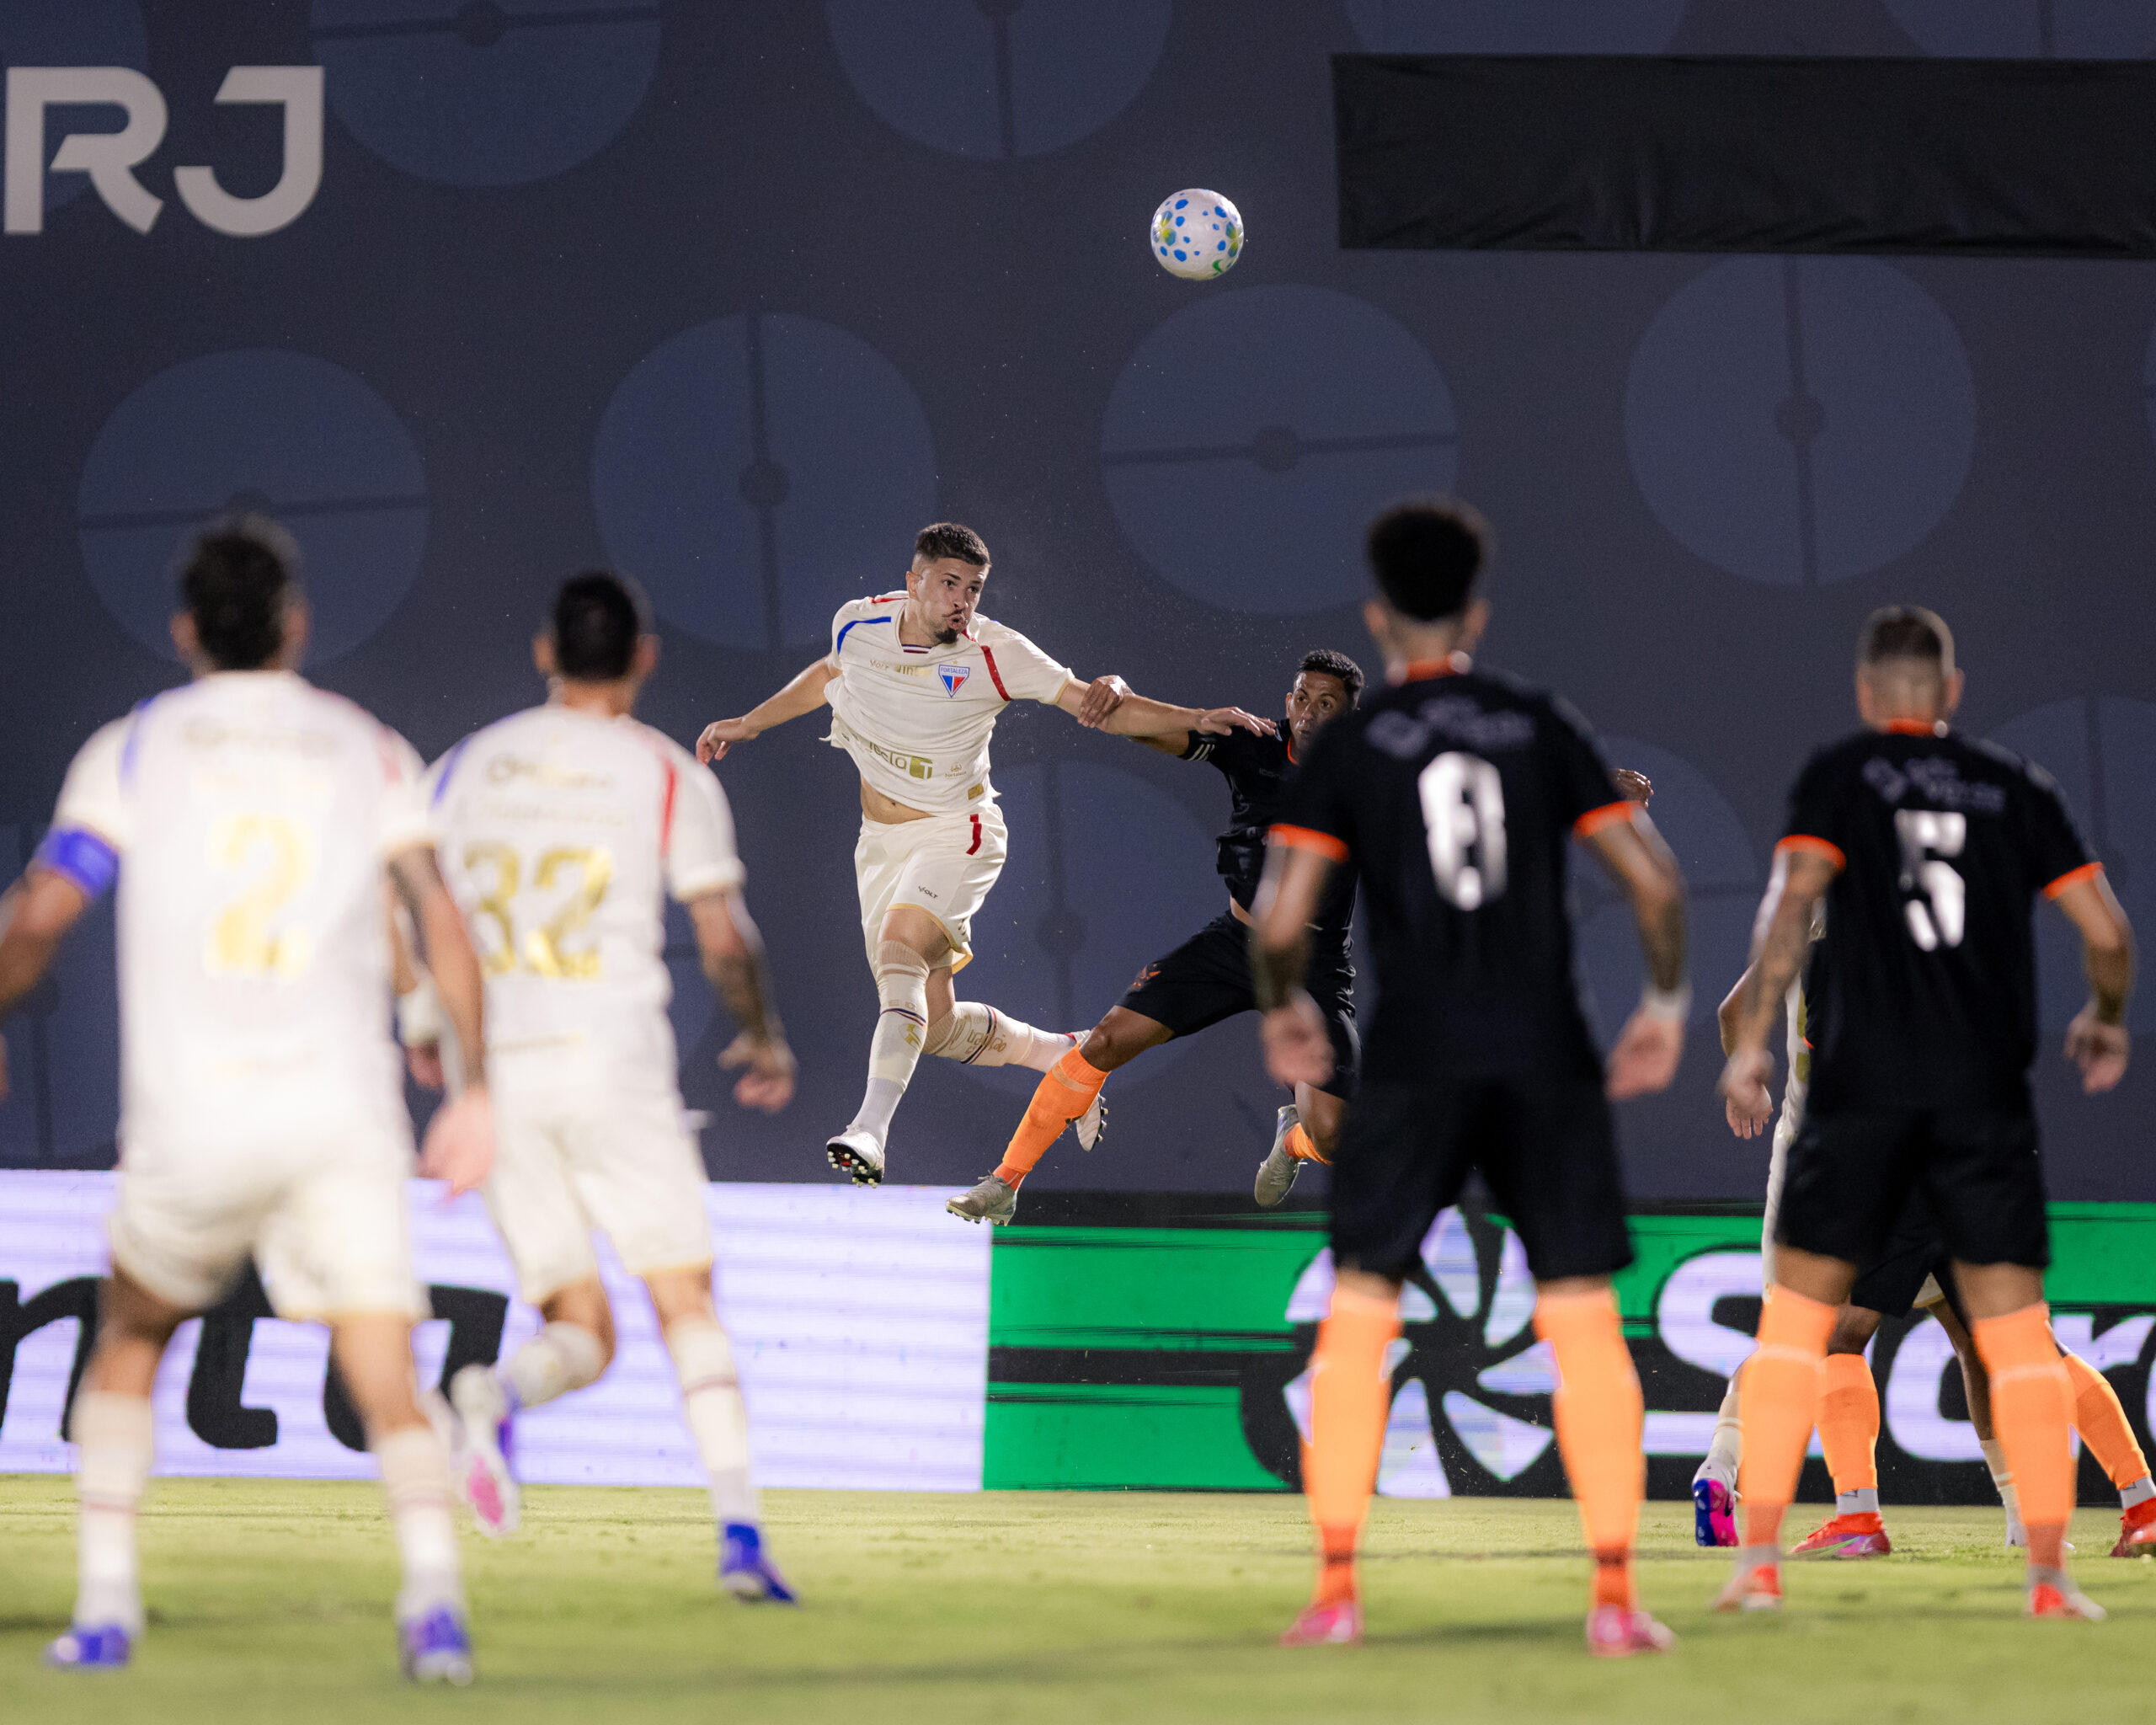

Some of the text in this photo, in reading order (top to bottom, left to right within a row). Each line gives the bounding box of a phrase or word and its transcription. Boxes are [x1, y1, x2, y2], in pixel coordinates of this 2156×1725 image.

[3, 66, 325, 238] RJ
[940, 666, 969, 675] FORTALEZA
[205, 812, 315, 975] 2
[462, 843, 615, 980] 32
[918, 885, 938, 899] VOLT
[1894, 808, 1967, 952] 5
